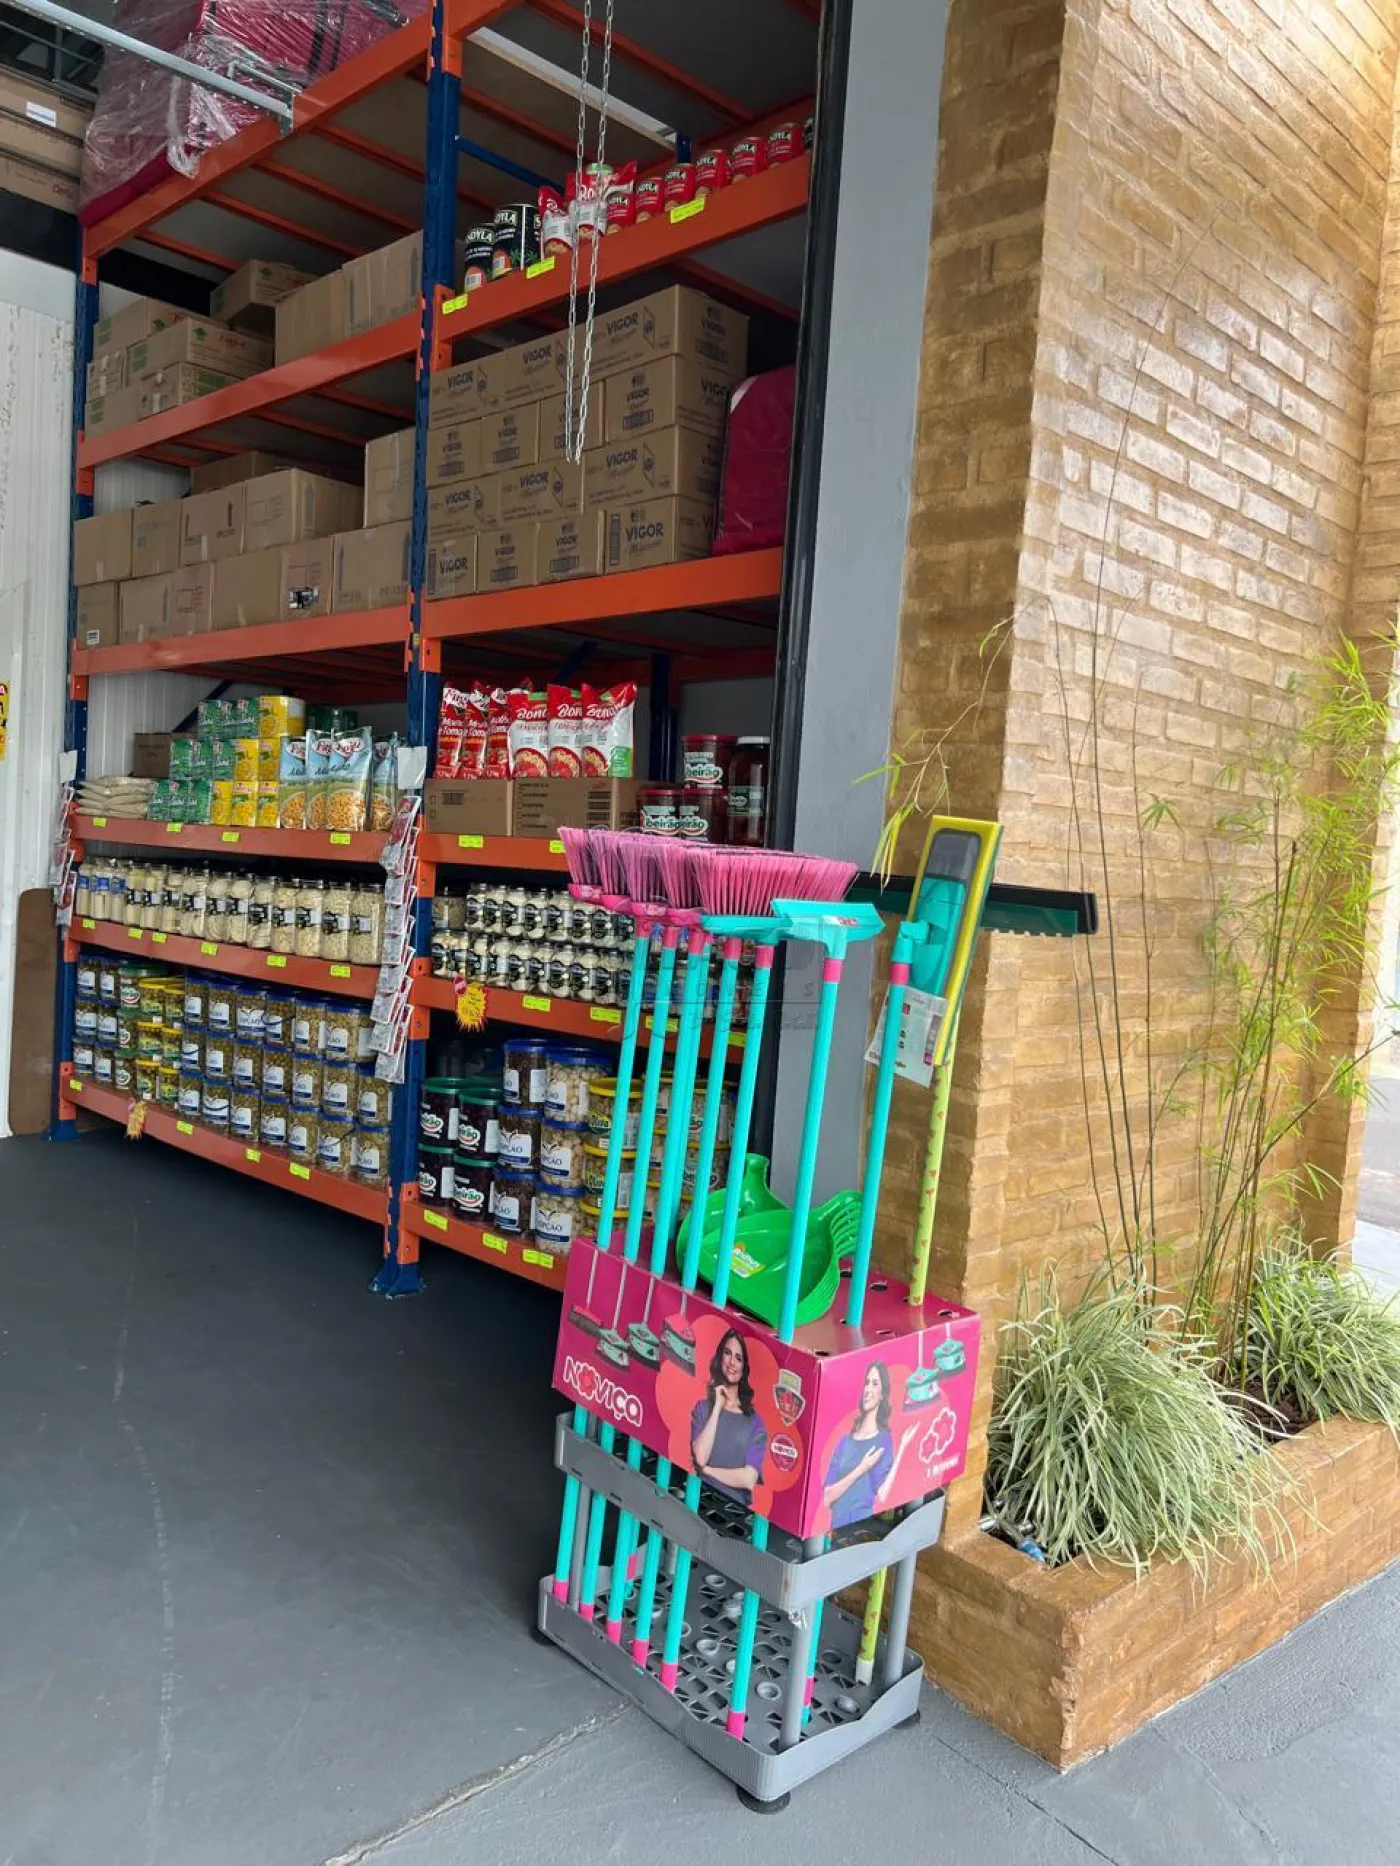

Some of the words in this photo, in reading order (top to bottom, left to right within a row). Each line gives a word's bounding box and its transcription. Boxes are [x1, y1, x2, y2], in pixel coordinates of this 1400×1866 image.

[606, 312, 639, 335] VIGOR
[523, 346, 552, 364] VIGOR
[447, 371, 474, 388] VIGOR
[606, 449, 638, 469] VIGOR
[520, 471, 549, 488] VIGOR
[625, 522, 664, 542] VIGOR
[439, 557, 468, 574] VIGOR
